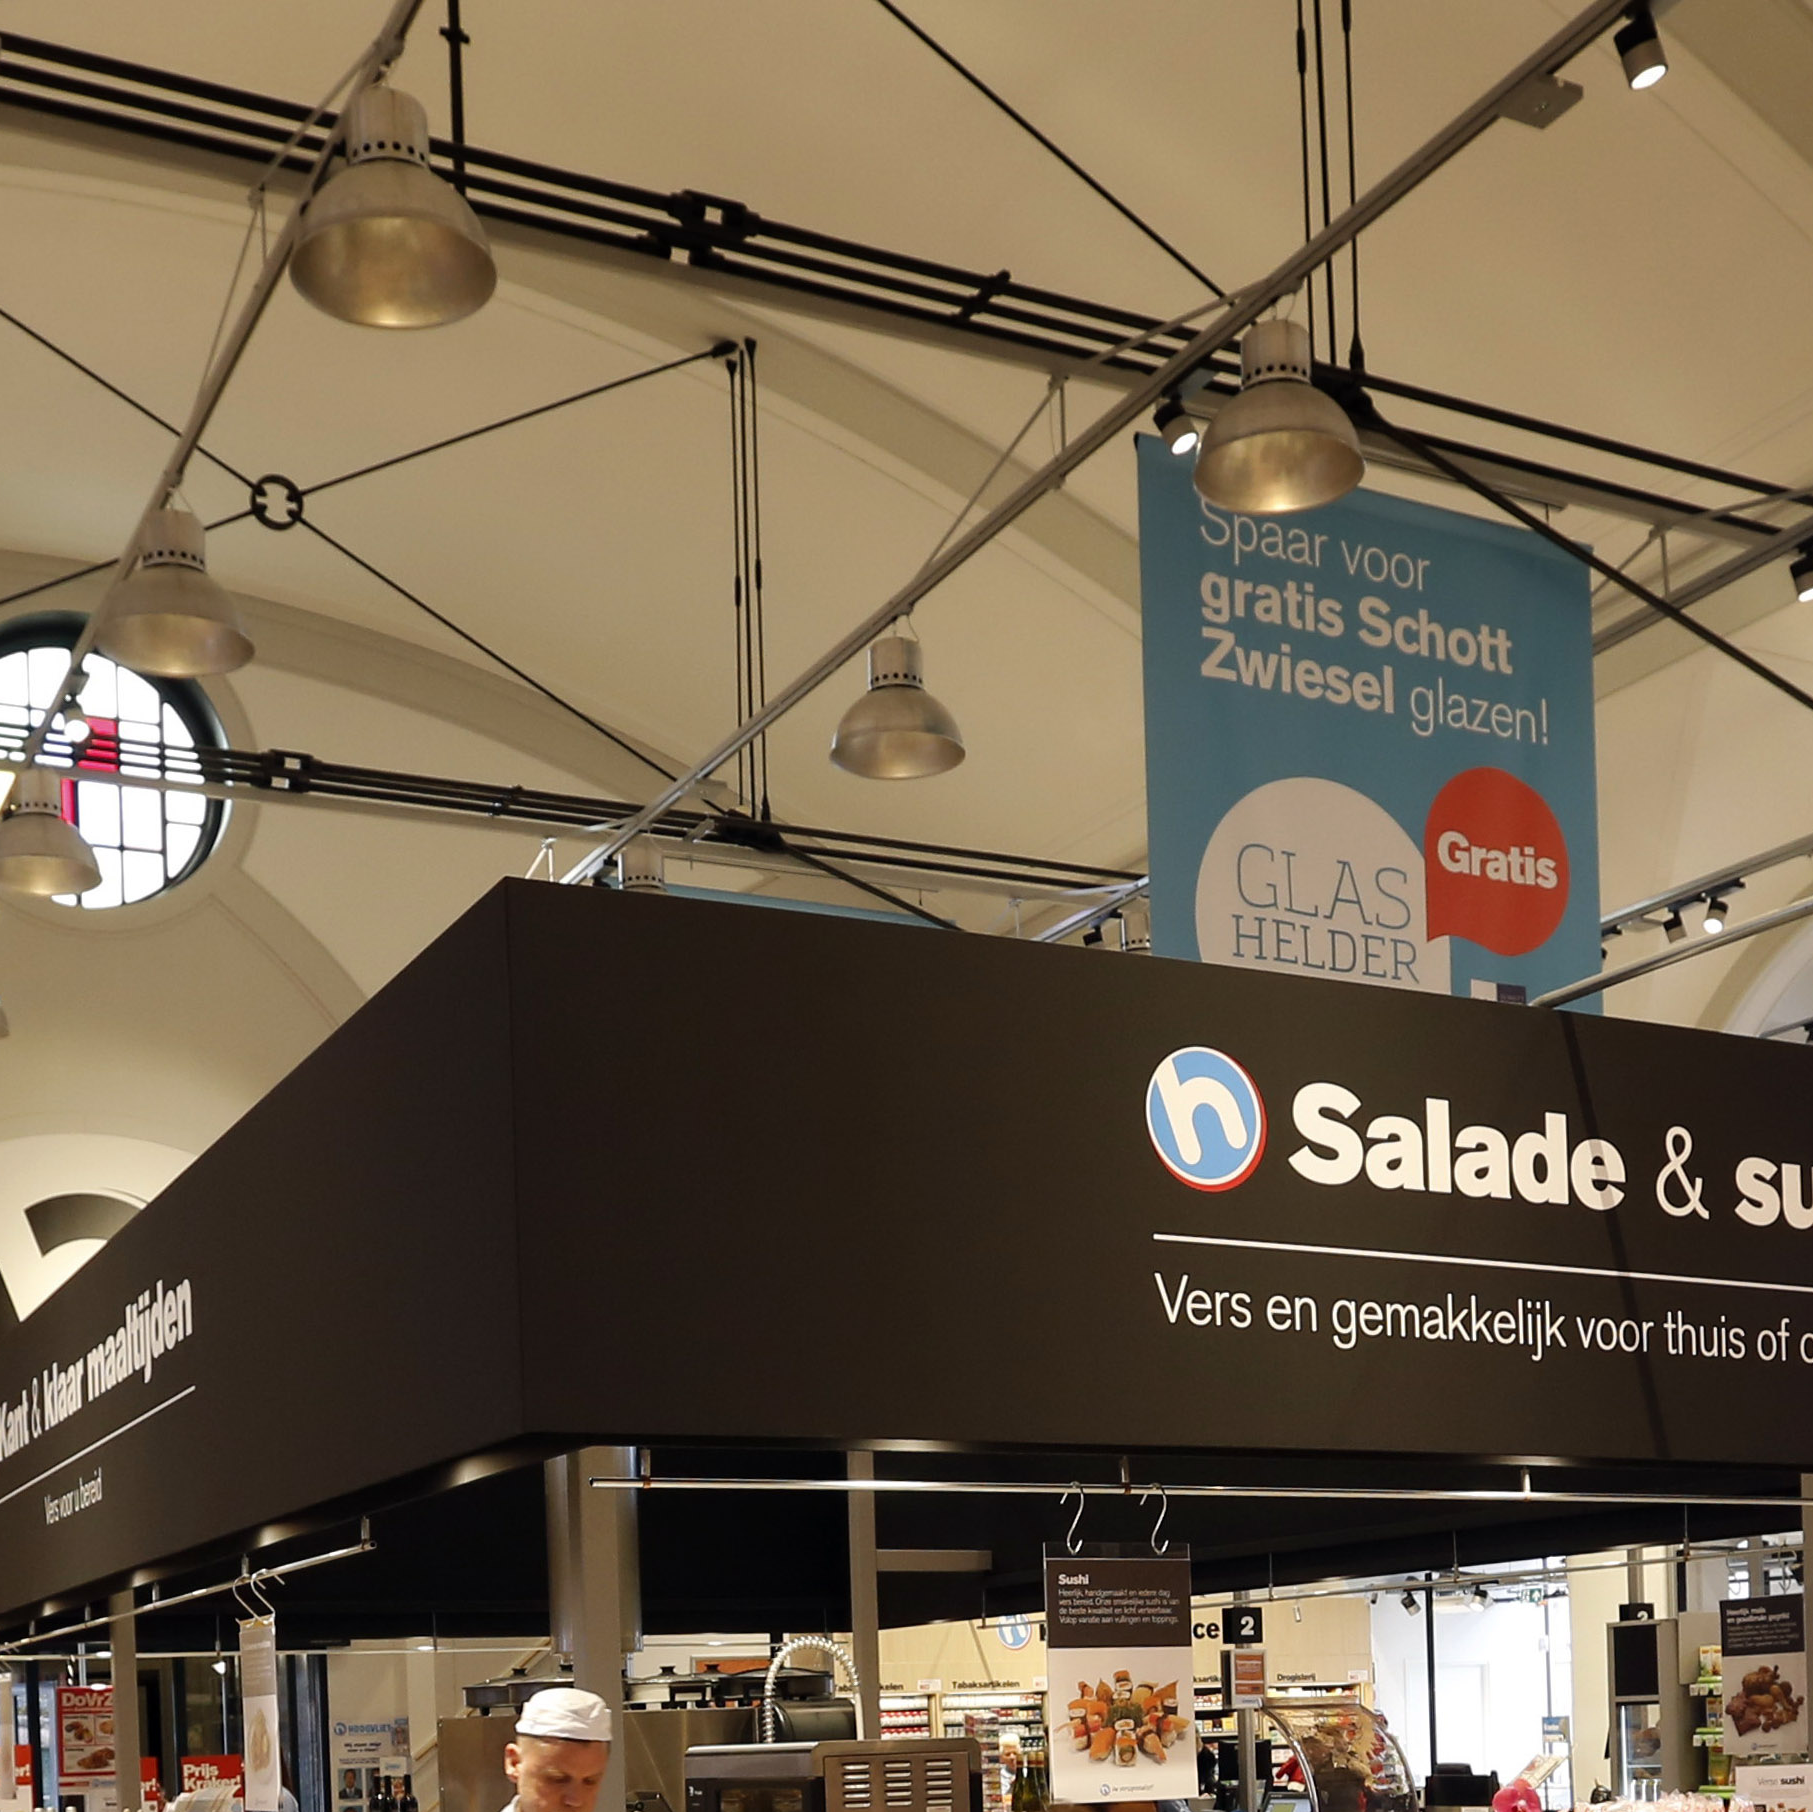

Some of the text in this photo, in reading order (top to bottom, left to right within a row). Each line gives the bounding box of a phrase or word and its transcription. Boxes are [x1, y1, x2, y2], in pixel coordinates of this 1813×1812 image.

[1199, 503, 1431, 591] Spaar voor
[1199, 570, 1514, 675] gratis Schott
[1199, 627, 1550, 745] Zwiesel glazen!
[1236, 842, 1411, 931] GLAS
[1436, 830, 1559, 889] Gratis
[1231, 913, 1420, 984] HELDER
[1287, 1081, 1626, 1212] Salade
[1655, 1125, 1710, 1221] &
[1154, 1271, 1253, 1331] Vers
[1266, 1287, 1318, 1332] en
[1331, 1292, 1566, 1362] gemakkelijk
[1575, 1314, 1655, 1354] voor
[1663, 1317, 1747, 1361] thuis
[1756, 1320, 1790, 1363] of
[30, 1376, 42, 1439] &
[42, 1360, 85, 1432] klaar
[86, 1278, 193, 1402] maaltijden
[1058, 1574, 1090, 1585] Sushi
[1240, 1615, 1255, 1636] 2
[61, 1691, 114, 1708] DoVrZ
[951, 1680, 1021, 1691] Tabaksartikelen
[182, 1762, 219, 1780] Prijs
[1780, 1775, 1805, 1785] sushi
